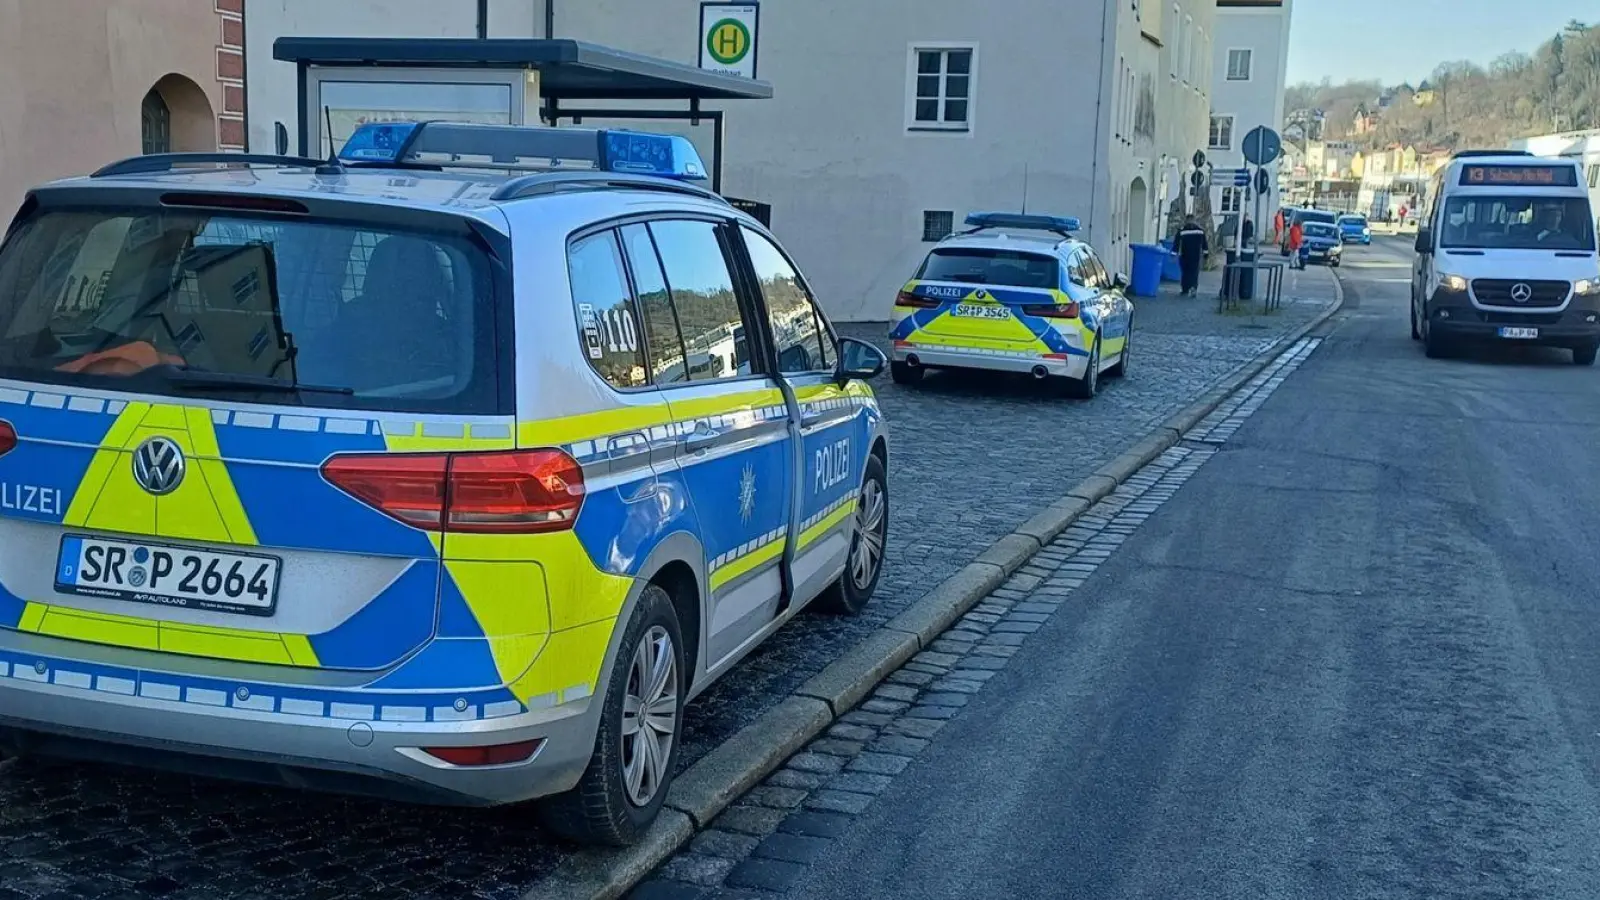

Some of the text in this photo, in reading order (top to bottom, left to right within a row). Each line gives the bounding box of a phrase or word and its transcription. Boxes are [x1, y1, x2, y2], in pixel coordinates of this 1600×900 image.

[719, 28, 738, 54] H
[925, 286, 961, 297] POLIZEI
[957, 304, 970, 316] SR
[976, 307, 983, 316] P
[603, 309, 637, 353] 110
[814, 437, 850, 494] POLIZEI
[63, 564, 73, 577] D
[80, 545, 269, 600] SR P 2664
[148, 595, 187, 606] AUTOLAND
